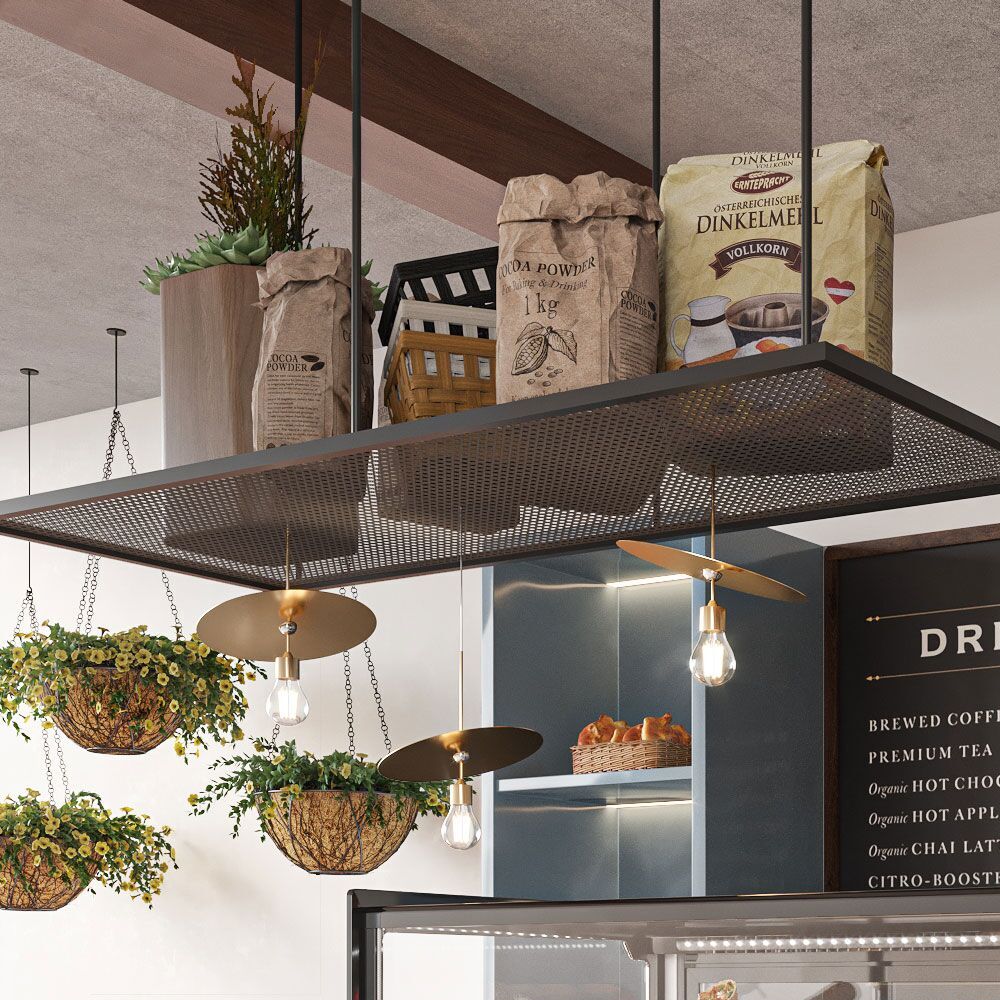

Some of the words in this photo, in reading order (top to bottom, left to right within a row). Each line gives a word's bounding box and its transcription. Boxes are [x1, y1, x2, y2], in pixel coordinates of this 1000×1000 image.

[734, 175, 791, 191] ERNTEPRACHT
[726, 243, 790, 261] VOLLKORN
[536, 256, 596, 277] POWDER
[525, 295, 530, 316] 1
[536, 292, 560, 319] kg
[620, 290, 647, 308] COCOA
[620, 299, 653, 320] POWDER
[266, 362, 307, 372] POWDER
[869, 714, 941, 733] BREWED
[869, 746, 952, 764] PREMIUM
[959, 743, 993, 758] TEA
[868, 780, 908, 799] Organic
[912, 777, 950, 793] HOT
[868, 811, 908, 829] Organic
[912, 808, 950, 824] HOT
[868, 843, 908, 861] Organic
[911, 840, 956, 856] CHAI
